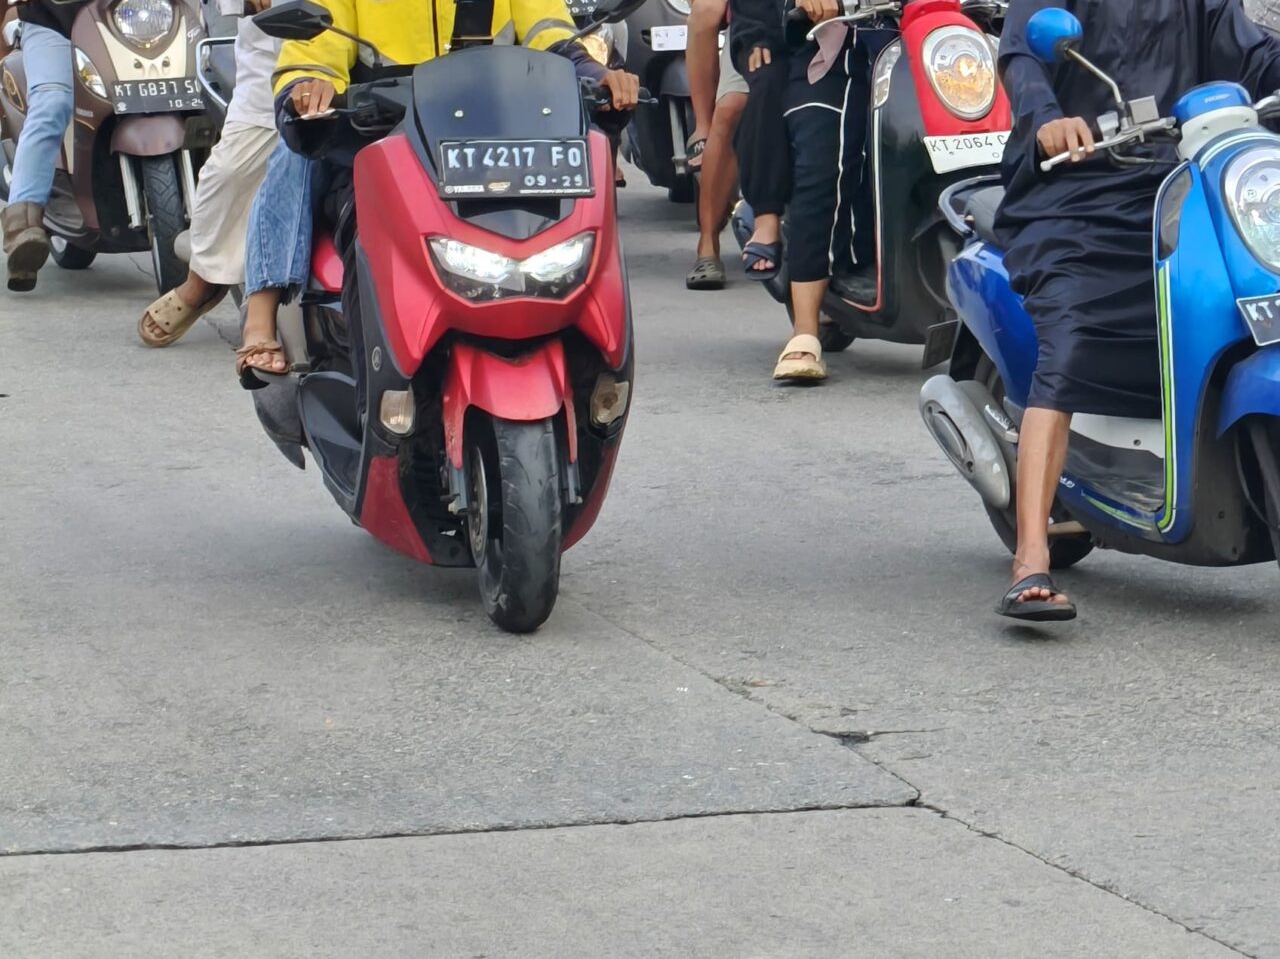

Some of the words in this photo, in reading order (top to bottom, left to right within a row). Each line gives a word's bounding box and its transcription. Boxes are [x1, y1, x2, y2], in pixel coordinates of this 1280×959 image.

[115, 84, 132, 97] KT
[929, 139, 949, 152] KT
[955, 137, 993, 150] 2064
[997, 134, 1007, 146] C
[448, 148, 475, 169] KT
[483, 147, 535, 168] 4217
[1246, 300, 1276, 322] KT
